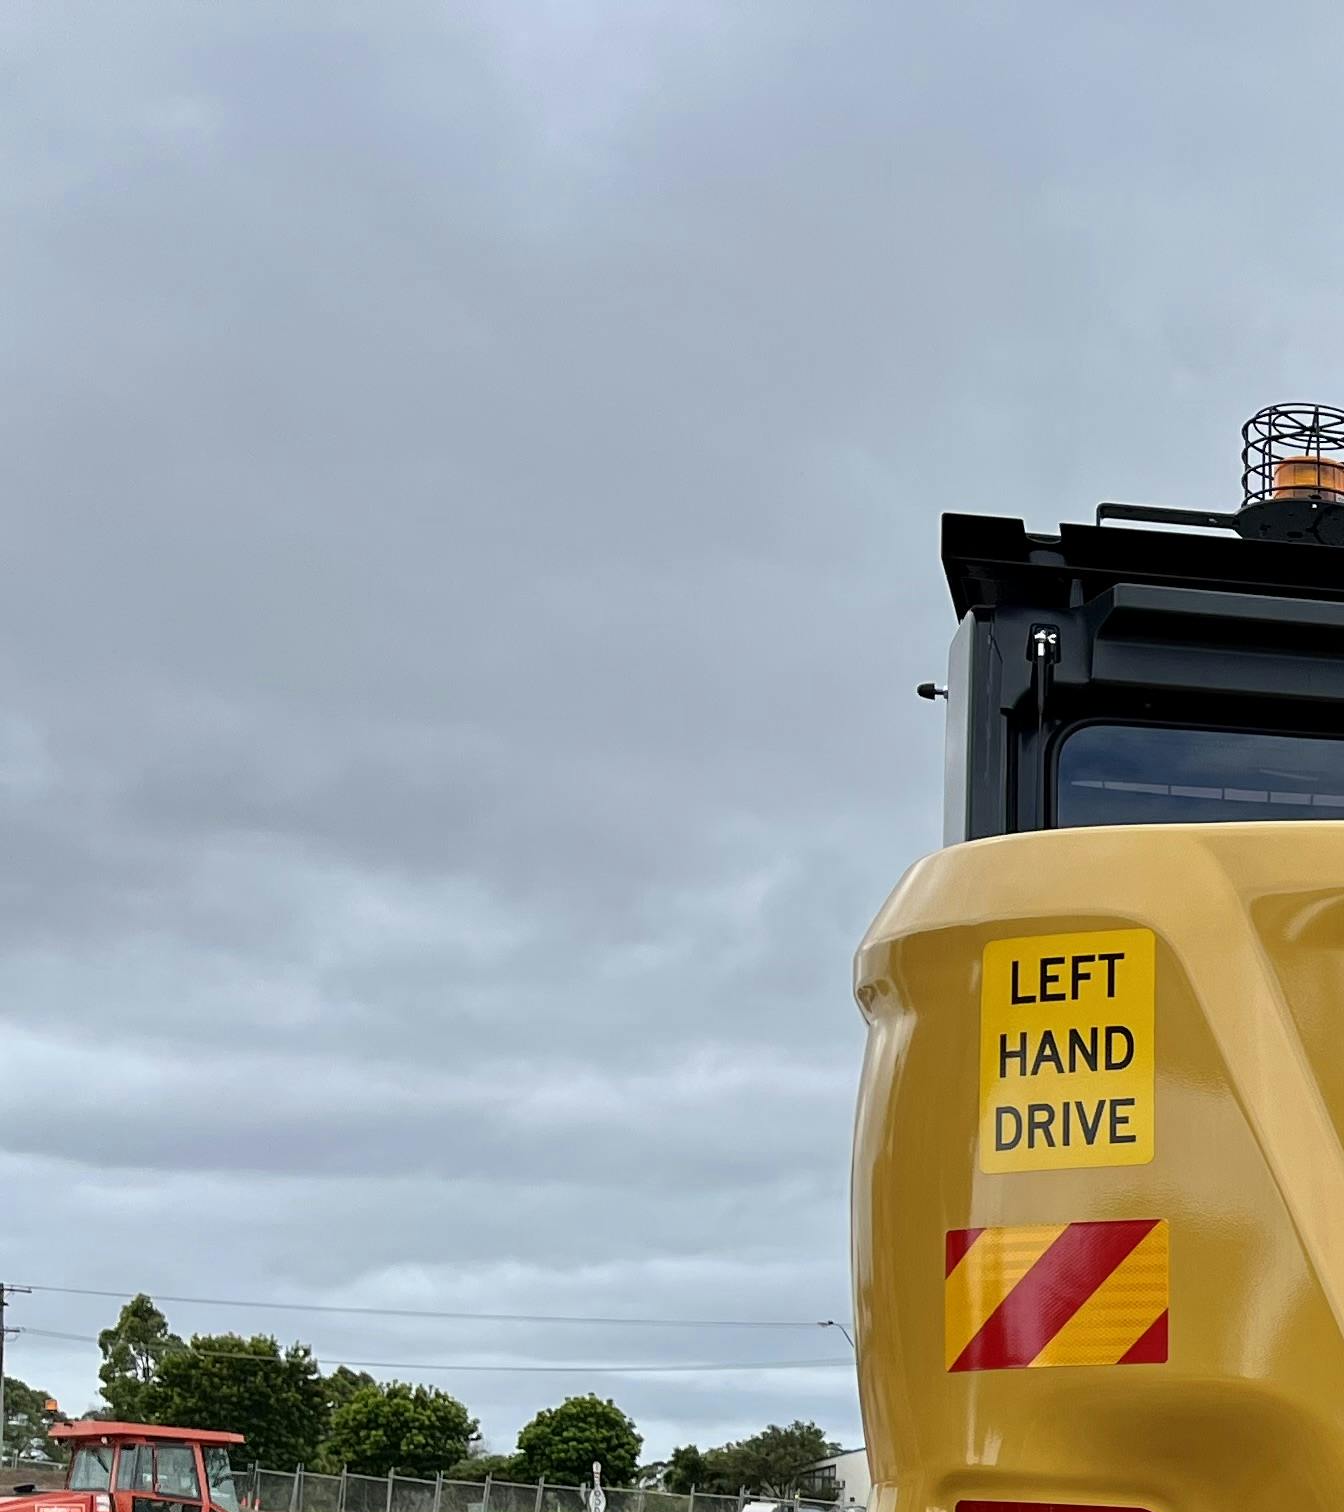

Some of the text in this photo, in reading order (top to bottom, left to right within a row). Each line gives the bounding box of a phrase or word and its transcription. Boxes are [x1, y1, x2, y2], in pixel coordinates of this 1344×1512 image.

[1011, 952, 1125, 1005] LEFT
[999, 1025, 1135, 1078] HAND
[995, 1097, 1137, 1152] DRIVE
